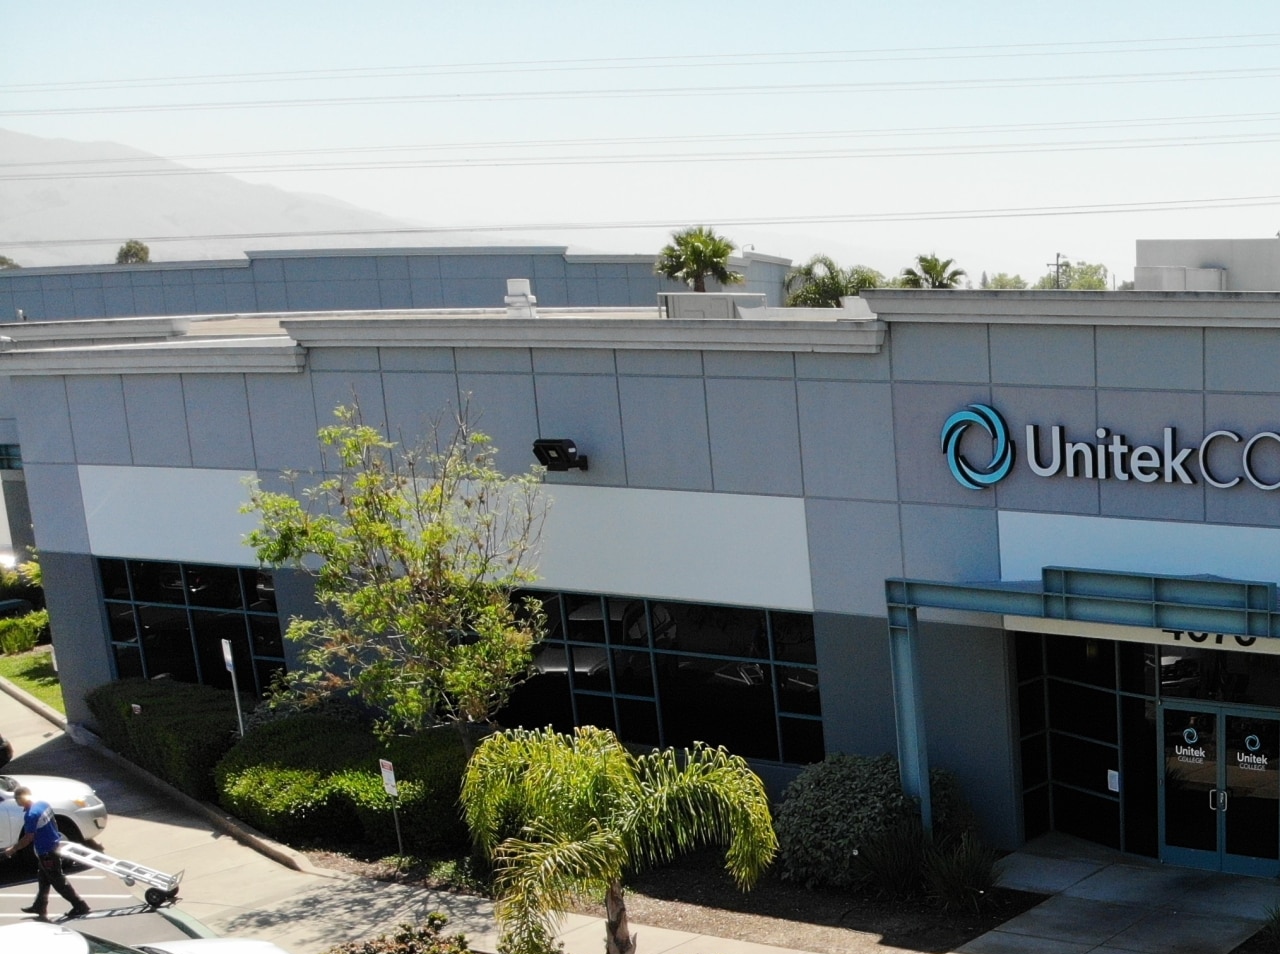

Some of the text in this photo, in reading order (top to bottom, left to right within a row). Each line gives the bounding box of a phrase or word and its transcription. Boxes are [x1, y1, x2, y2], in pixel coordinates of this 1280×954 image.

[1175, 745, 1206, 758] Unitek
[1177, 755, 1204, 764] COLLEGE
[1236, 752, 1268, 765] Unitek
[1238, 763, 1266, 771] COLLEGE
